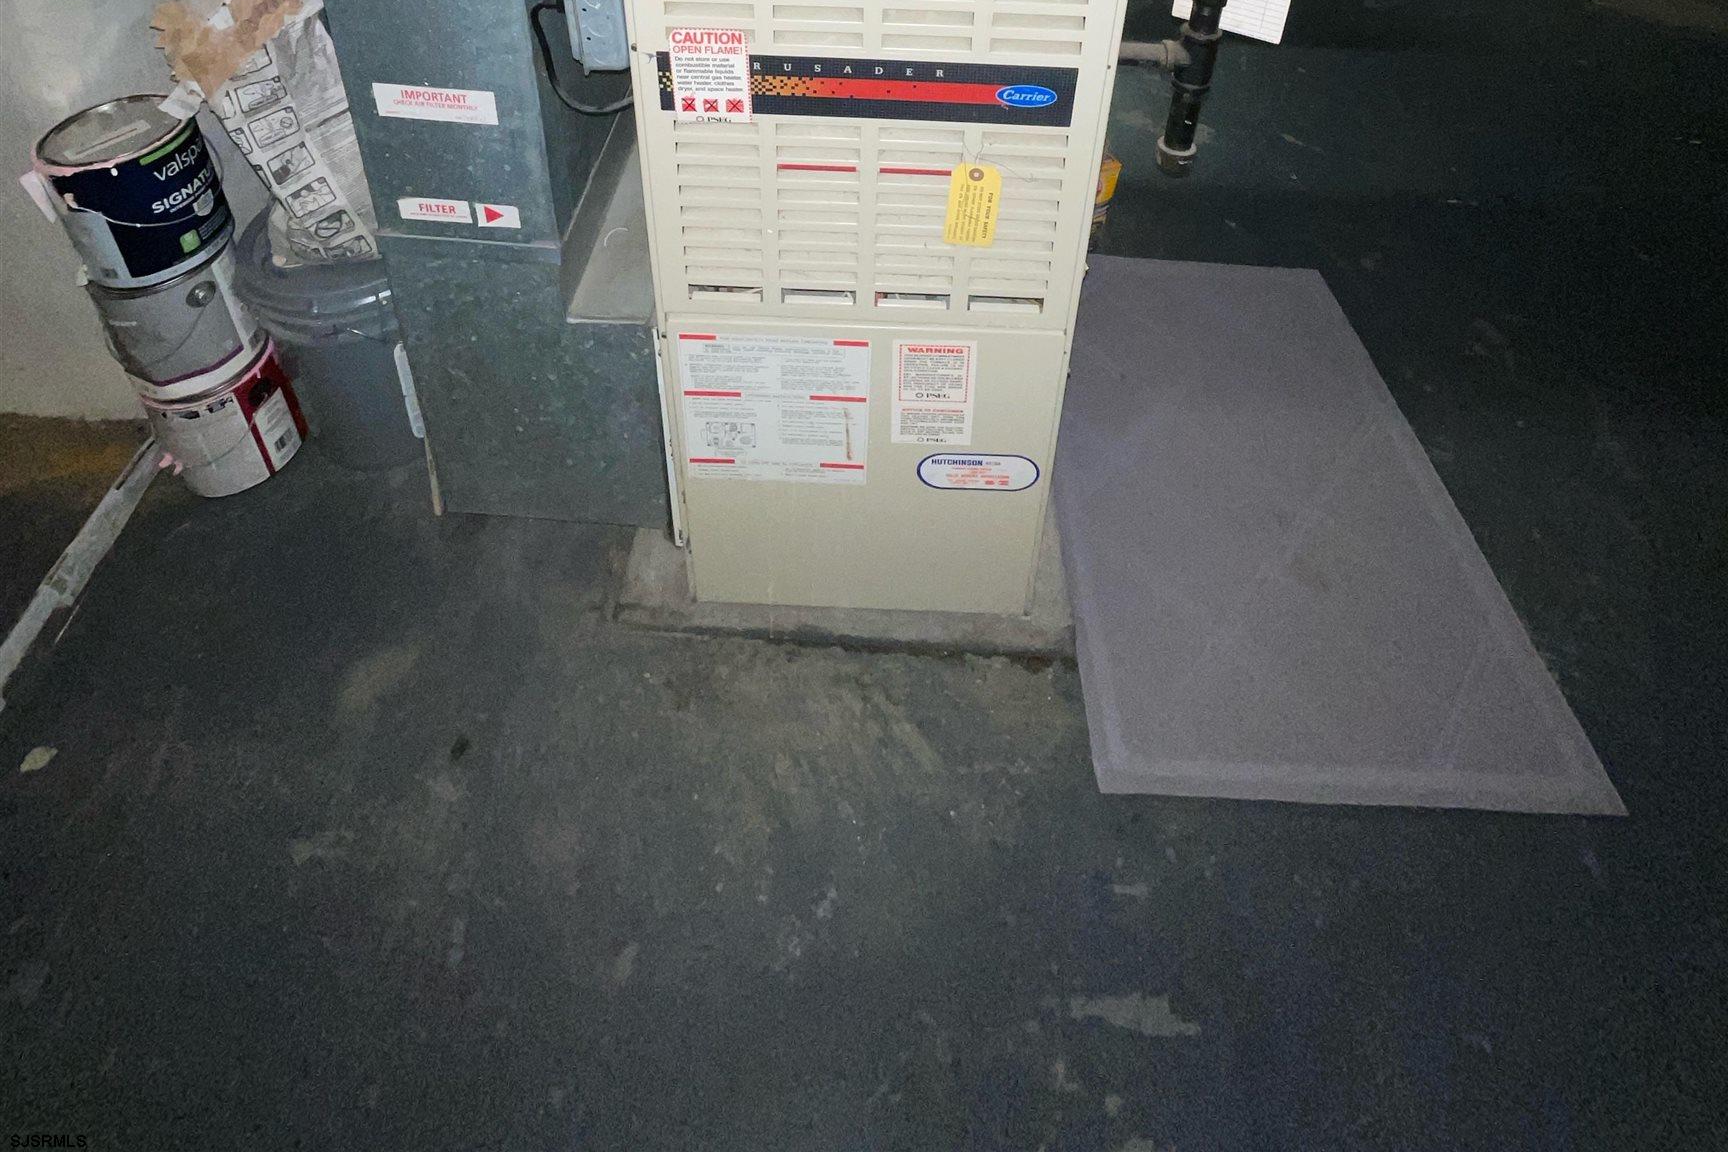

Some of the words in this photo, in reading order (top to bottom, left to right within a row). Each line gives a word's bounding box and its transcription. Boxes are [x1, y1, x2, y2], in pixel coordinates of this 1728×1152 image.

[672, 31, 742, 44] CAUTION
[672, 45, 702, 54] OPEN
[704, 46, 743, 55] FLAME!
[753, 61, 945, 78] RUSADER
[400, 89, 467, 104] IMPORTANT
[1002, 89, 1051, 102] Carrier
[393, 98, 414, 106] CHECK
[446, 103, 478, 111] MONTHLY
[418, 203, 457, 214] FILTER
